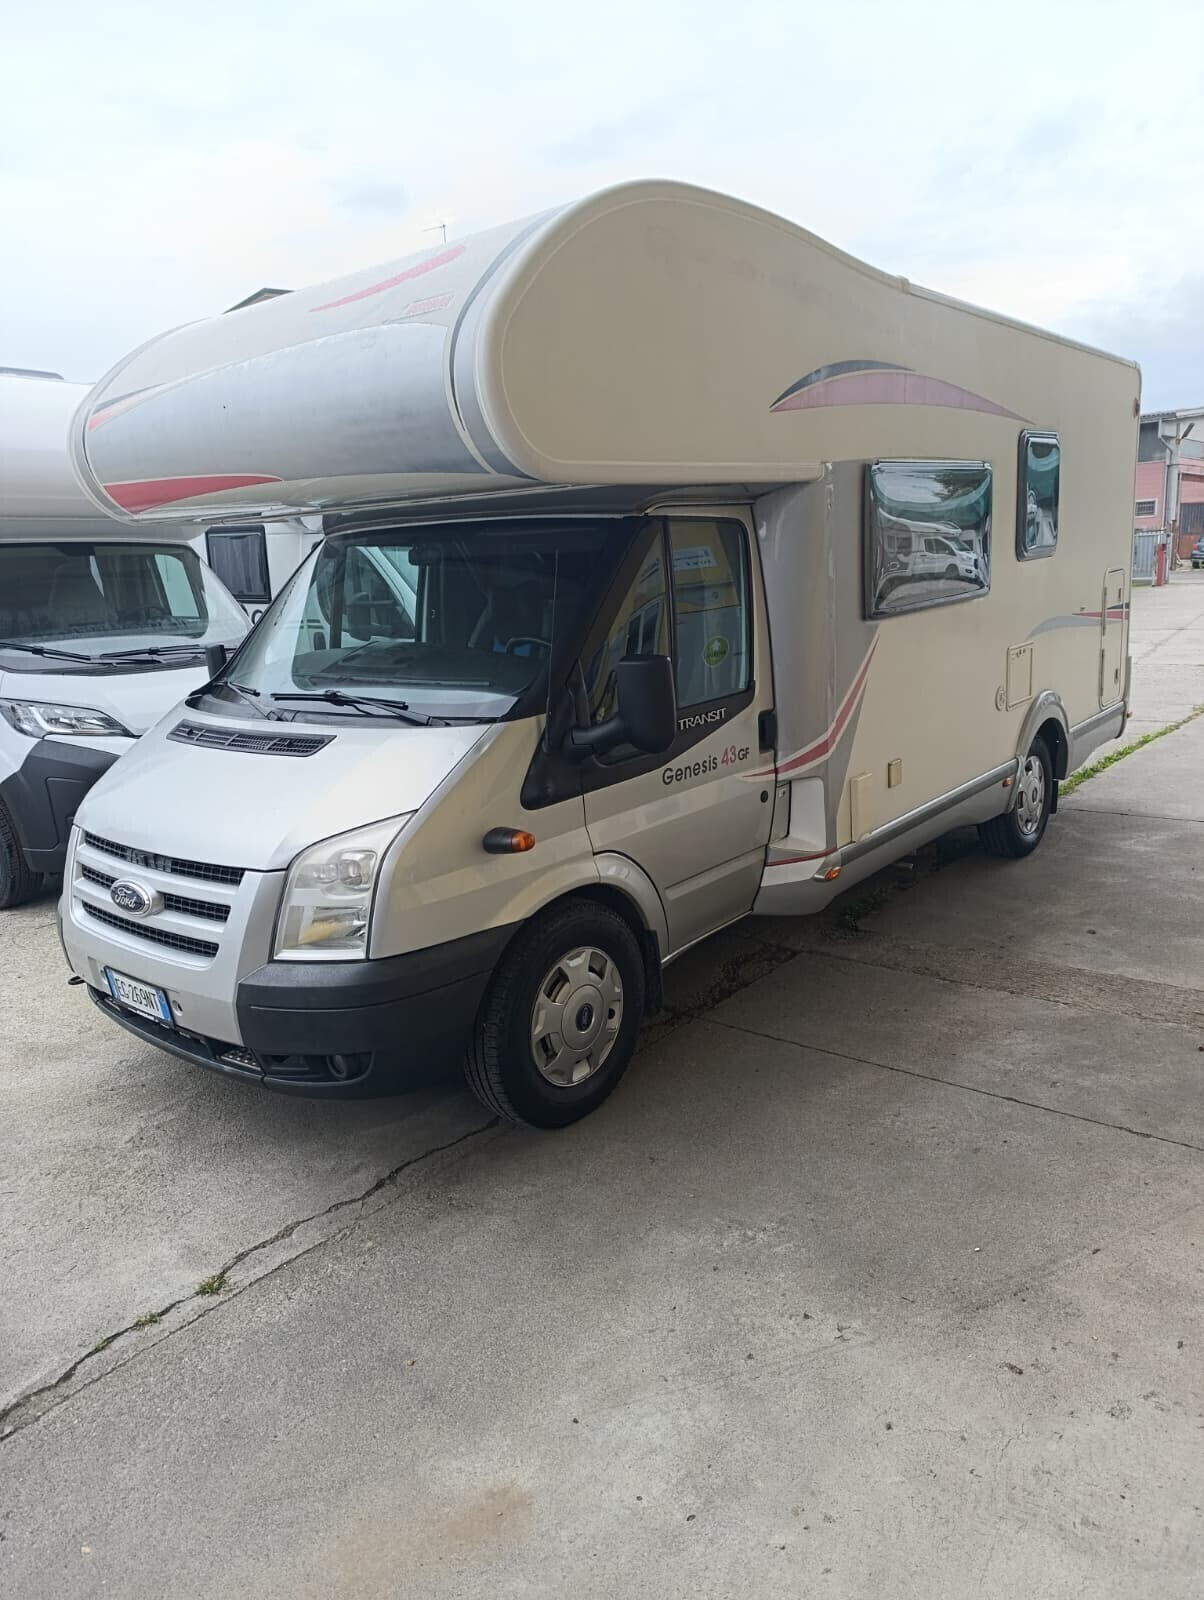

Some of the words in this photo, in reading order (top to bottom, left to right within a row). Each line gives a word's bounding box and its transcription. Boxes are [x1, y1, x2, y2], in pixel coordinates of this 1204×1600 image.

[678, 708, 726, 730] TRANSIT
[662, 755, 718, 785] Genesis
[114, 887, 136, 909] Ford
